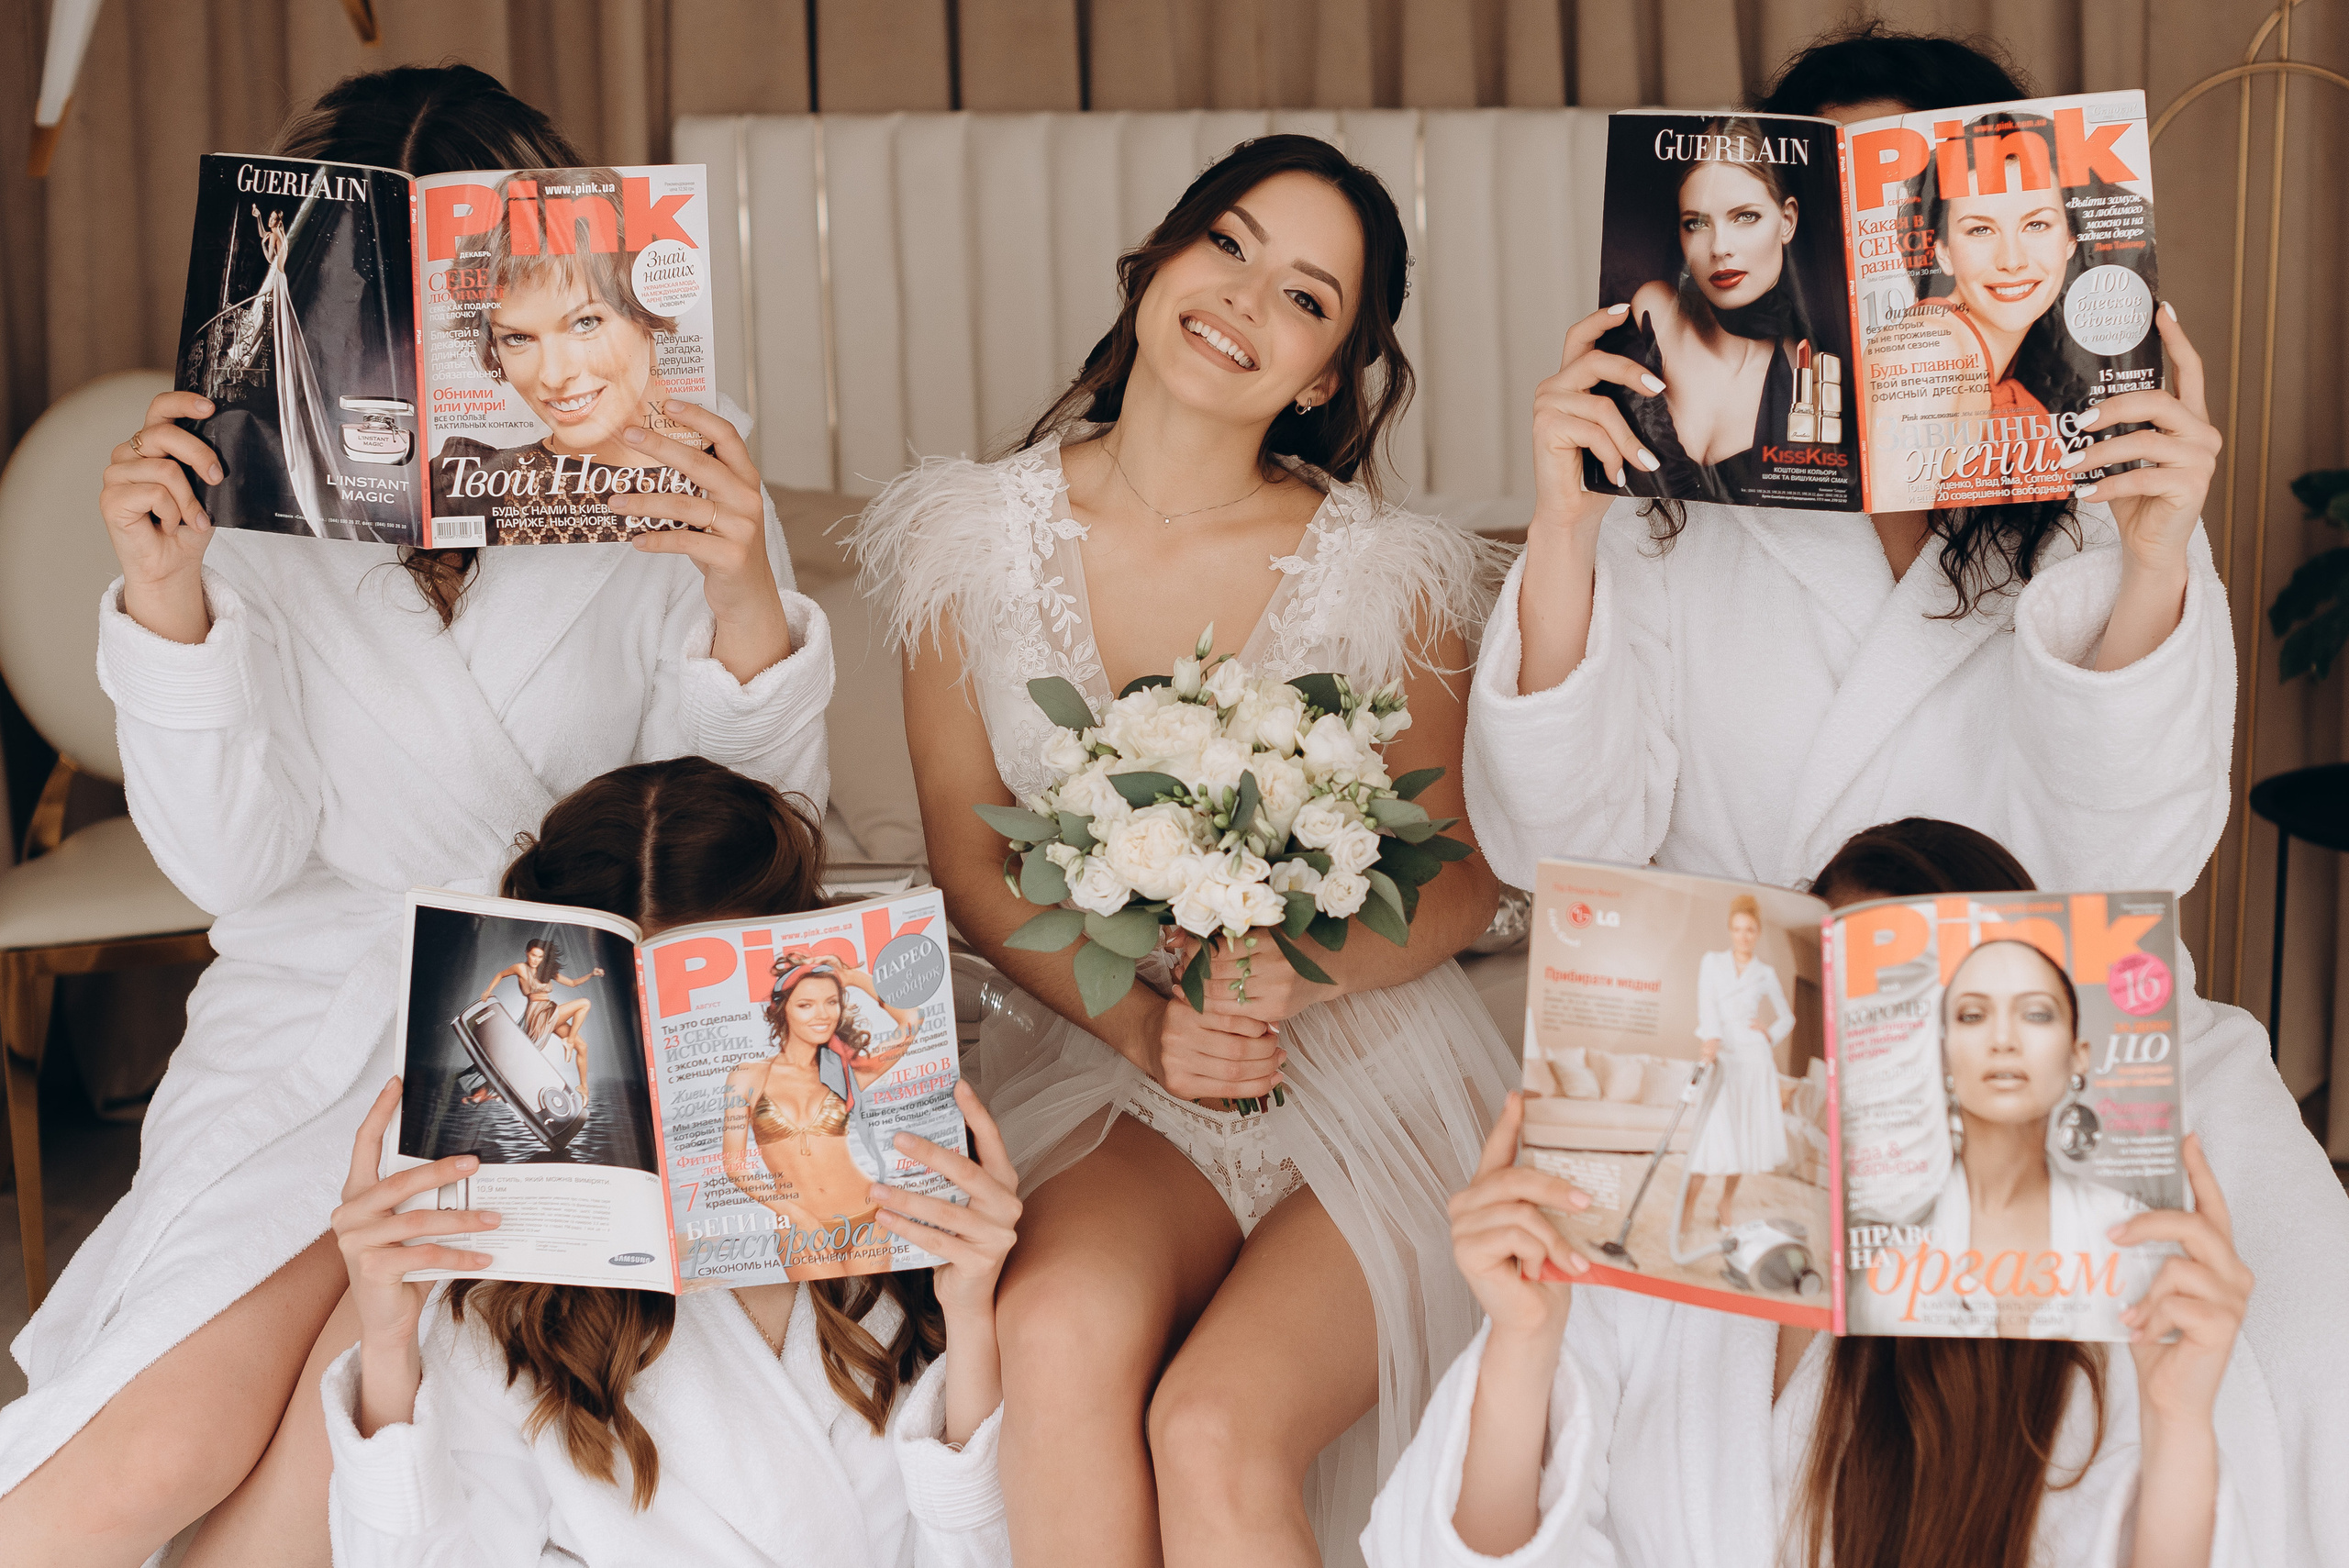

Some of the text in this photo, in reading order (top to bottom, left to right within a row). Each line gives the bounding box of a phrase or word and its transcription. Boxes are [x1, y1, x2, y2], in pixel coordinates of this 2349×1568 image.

[1974, 119, 2047, 133] www.pink.com.ua
[1654, 128, 1809, 166] GUERLAIN
[1853, 107, 2139, 211] Pink
[237, 163, 368, 203] GUERLAIN
[545, 182, 615, 195] www.pink.ua
[2065, 195, 2143, 208] «Выйти замуж
[425, 176, 699, 261] Pink
[2082, 205, 2143, 218] за любимого
[1858, 217, 1909, 237] Какая
[2085, 217, 2143, 229] можно на
[1858, 229, 1936, 259] СЕКСЕ
[2076, 228, 2144, 242] заднем дворе»
[646, 247, 686, 268] Знай
[1861, 250, 1935, 279] разница?
[429, 268, 492, 292] СЕБЕ
[643, 264, 695, 283] наших
[2089, 270, 2131, 294] 100
[429, 284, 504, 305] ЛЮБИМОЙ
[2076, 295, 2143, 312] блесков
[447, 302, 502, 311] КАК ПОДАРОК
[1863, 288, 1906, 325] 10
[1885, 301, 1969, 321] дизайнеров,
[1865, 320, 1925, 334] без которых
[2074, 308, 2149, 334] Givenchy
[430, 327, 471, 340] Блистай
[656, 334, 704, 346] Девушка-
[1880, 335, 1891, 343] не
[1894, 328, 1952, 343] проживешь
[430, 339, 477, 350] декабре:
[663, 344, 704, 355] загадка,
[1875, 340, 1940, 354] новом сезоне
[430, 350, 476, 362] длинное
[659, 356, 705, 366] девушка-
[431, 361, 466, 371] платье
[432, 368, 502, 381] обязательно!
[650, 365, 705, 377] бриллиант
[1870, 353, 1979, 382] Будь главной!
[2099, 368, 2154, 382] 15 минут
[655, 377, 706, 386] НОВОГОДНИЕ
[1870, 369, 1990, 391] Твой впечатляющий
[2089, 380, 2155, 396] до идеала:
[433, 387, 494, 401] Обними
[665, 385, 707, 394] МАКИЯЖИ
[1871, 383, 1992, 403] ОФИСНЫЙ ДРЕСС-КОД
[434, 399, 506, 414] или умри!
[434, 422, 486, 430] ТАКТИЛЬНЫХ
[1901, 414, 1918, 422] Pink
[1876, 412, 2082, 452] Завидные
[327, 473, 409, 492] L'INSTANT
[442, 456, 540, 498] Твой
[1932, 469, 2106, 493] Куценко, Влад Comedy UA
[341, 489, 395, 504] MAGIC
[1937, 491, 1949, 502] 20
[1951, 488, 2010, 502] совершенно
[2011, 484, 2065, 496] свободных
[492, 505, 577, 517] БУДЬ НАМИ В
[496, 517, 546, 528] ПАРИЖЕ,
[550, 512, 617, 527] НЬЮ-ЙОРКЕ
[1596, 909, 1620, 928] LG
[781, 922, 852, 940] www.pink.com.ua
[653, 907, 935, 1018] Pink
[874, 940, 934, 984] ПАРЕО
[885, 965, 942, 1005] подарок
[1545, 966, 1662, 993] Прибирати модно!
[2121, 962, 2161, 1009] 16
[695, 1001, 721, 1011] АВГУСТ
[661, 1011, 751, 1035] Ты это сделала!
[663, 1025, 729, 1050] 23 СЕКС
[919, 1030, 948, 1043] правил
[665, 1036, 753, 1062] ИСТОРИИ:
[674, 1051, 769, 1072] эксом, другом,
[890, 1057, 951, 1087] ДЕЛО В
[671, 1088, 710, 1106] Живи,
[874, 1073, 952, 1105] РАЗМЕРЕ!
[672, 1087, 753, 1120] хочешь!
[861, 1109, 880, 1119] Ешь
[895, 1108, 931, 1123] больше,
[672, 1117, 722, 1133] Мы знаем
[674, 1123, 746, 1141] который точно
[674, 1136, 723, 1151] сработает
[676, 1148, 762, 1170] Фитнес для
[703, 1172, 784, 1189] эффективных
[680, 1182, 699, 1213] 7
[704, 1182, 777, 1201] упражнений
[706, 1193, 799, 1210] краешке дивана
[687, 1212, 791, 1240] БЕГИ на
[614, 1255, 651, 1264] SAMSUNG
[698, 1244, 910, 1276] СЭКОНОМЬ НА ОСЕННЕМ ГАРДЕРОБЕ
[1849, 1246, 1892, 1271] НА
[1866, 1241, 2125, 1322] оргазм
